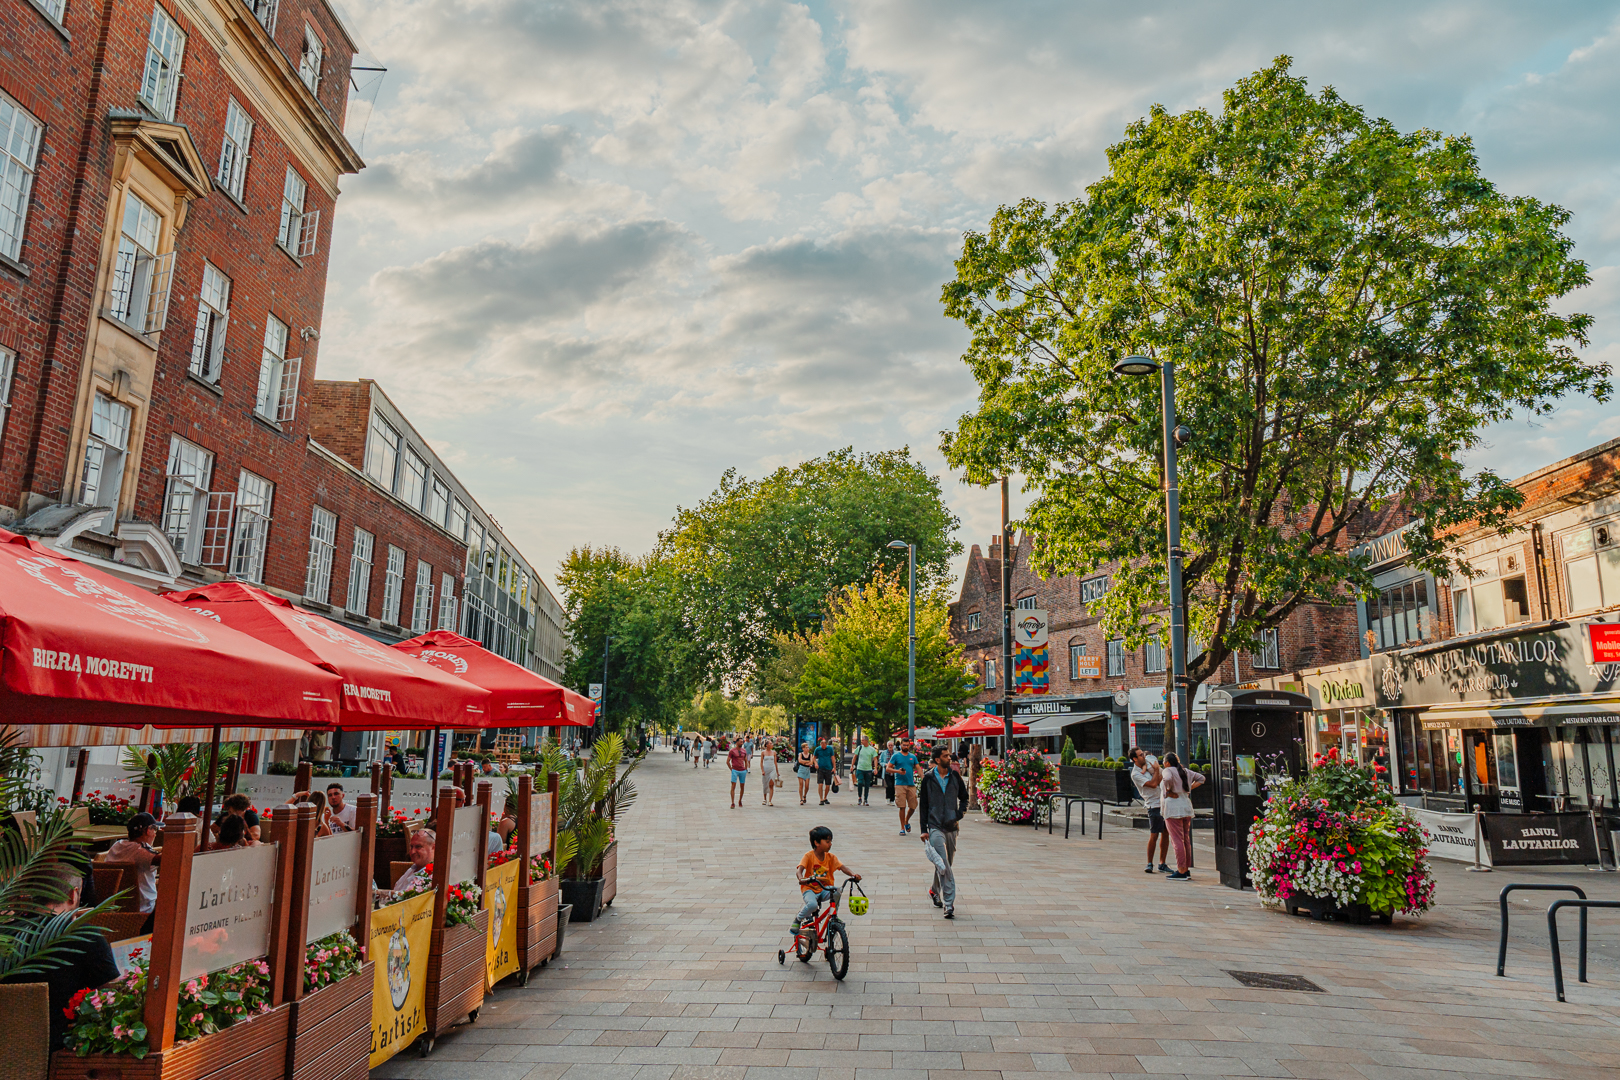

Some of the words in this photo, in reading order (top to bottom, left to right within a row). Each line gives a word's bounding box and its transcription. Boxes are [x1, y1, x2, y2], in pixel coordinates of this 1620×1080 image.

[33, 648, 82, 673] BIRRA
[86, 656, 154, 683] MORETTI
[1414, 651, 1459, 679] HANUL
[1461, 639, 1562, 668] LAUTARILOR
[343, 683, 360, 699] RRA
[360, 686, 392, 702] MORETTI
[1331, 679, 1364, 700] Oxfam
[1457, 677, 1475, 693] BAR
[1485, 674, 1510, 690] CLUB
[1031, 702, 1060, 714] FRATELLI
[1437, 824, 1464, 834] HANUL
[1521, 828, 1558, 837] HANUL
[1502, 839, 1580, 849] LAUTARILOR
[189, 917, 229, 936] RISTORANTE
[370, 1003, 421, 1054] L'artista
